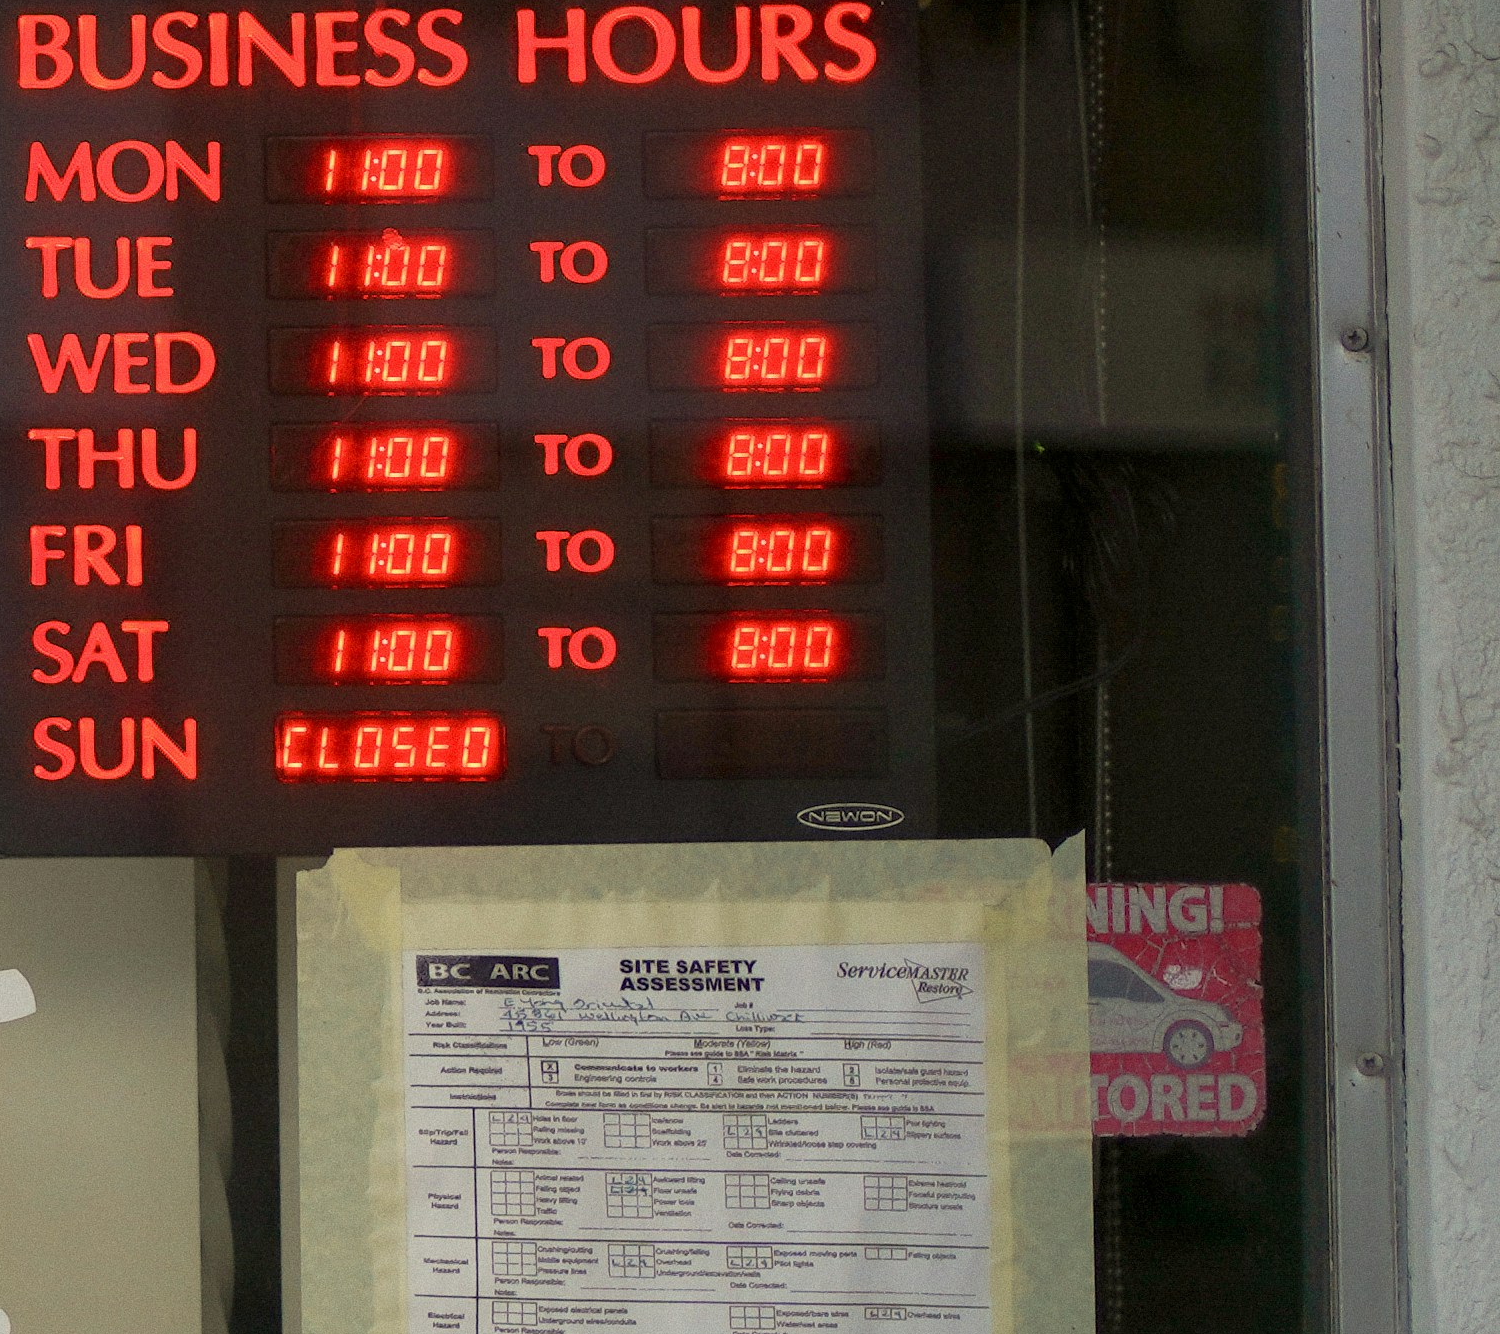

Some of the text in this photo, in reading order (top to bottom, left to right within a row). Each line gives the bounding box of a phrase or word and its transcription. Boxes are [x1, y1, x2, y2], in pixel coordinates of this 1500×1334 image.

[19, 4, 874, 89] BUSINESS HOURS
[25, 140, 824, 202] MON 11:00 TO 8:00
[26, 236, 826, 299] TUE 11:00 TO 8:00
[27, 332, 829, 394] WED 11:00 TO 8:00
[28, 428, 831, 490] THU 11:00 TO 8:00
[30, 525, 834, 587] FRI 11:00 TO 8:00
[32, 620, 836, 684] SAT 11:00 TO 8:00
[34, 717, 197, 780] SUN
[281, 724, 494, 773] CLOSED
[1088, 885, 1226, 935] NING!
[428, 963, 549, 981] BC ARC
[620, 959, 757, 975] SITE SAFETY
[620, 977, 764, 992] ASSESSMENT
[1091, 1072, 1257, 1123] TORED
